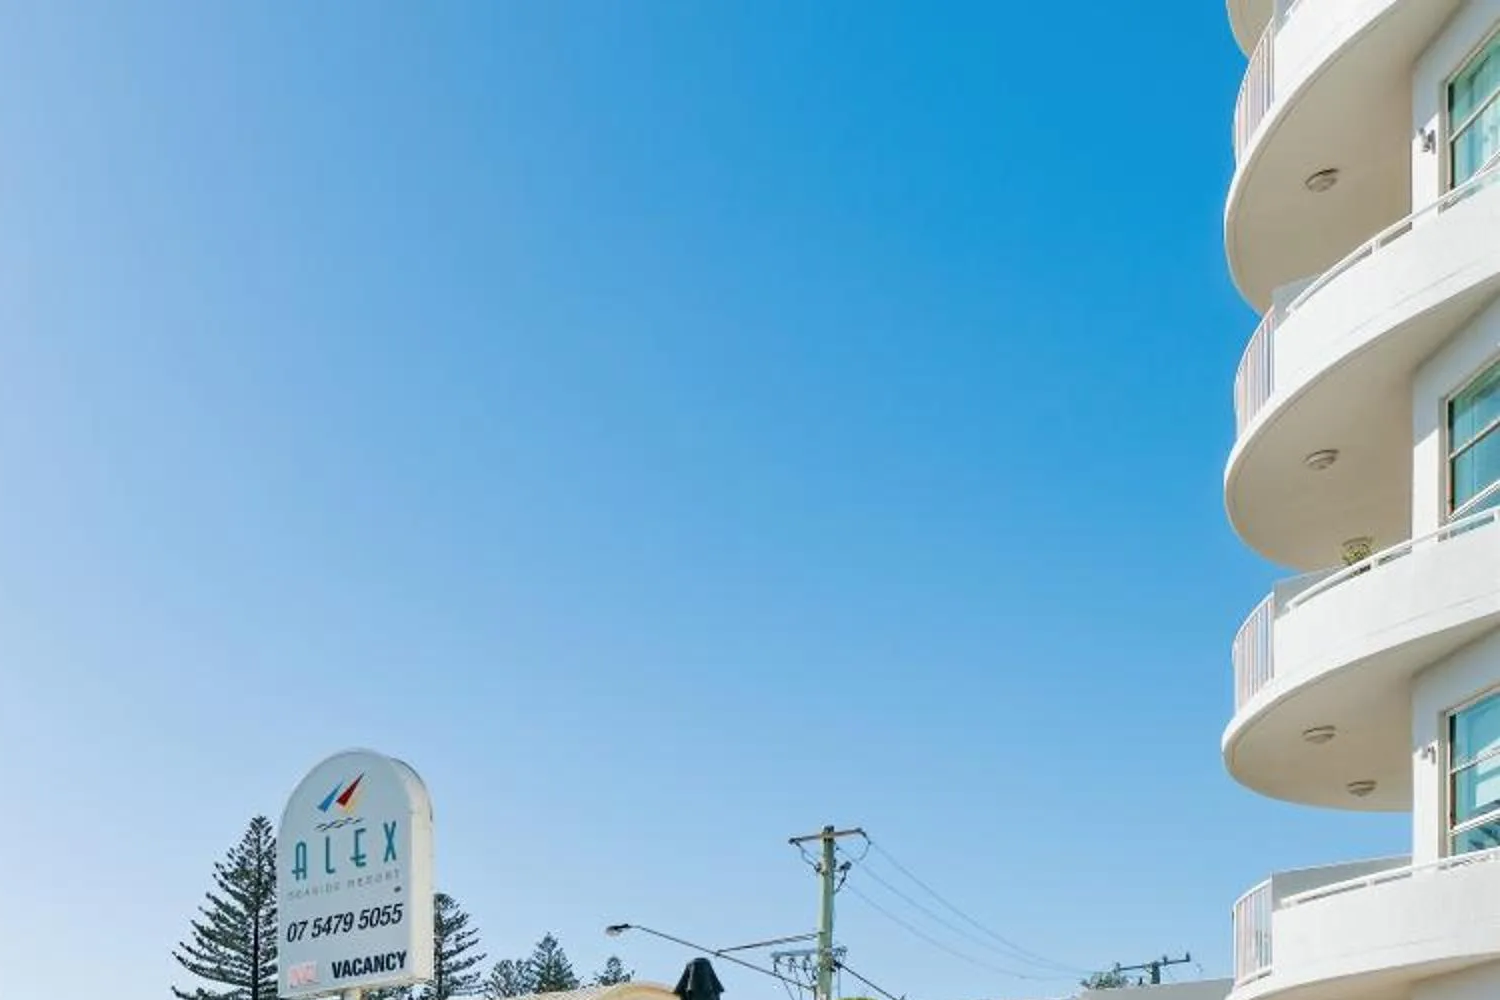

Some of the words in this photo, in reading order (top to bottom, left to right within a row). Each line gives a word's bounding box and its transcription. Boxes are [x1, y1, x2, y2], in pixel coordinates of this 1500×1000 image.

[291, 821, 397, 881] ALEX
[287, 920, 308, 942] 07
[312, 912, 355, 938] 5479
[358, 903, 404, 930] 5055
[331, 950, 407, 979] VACANCY
